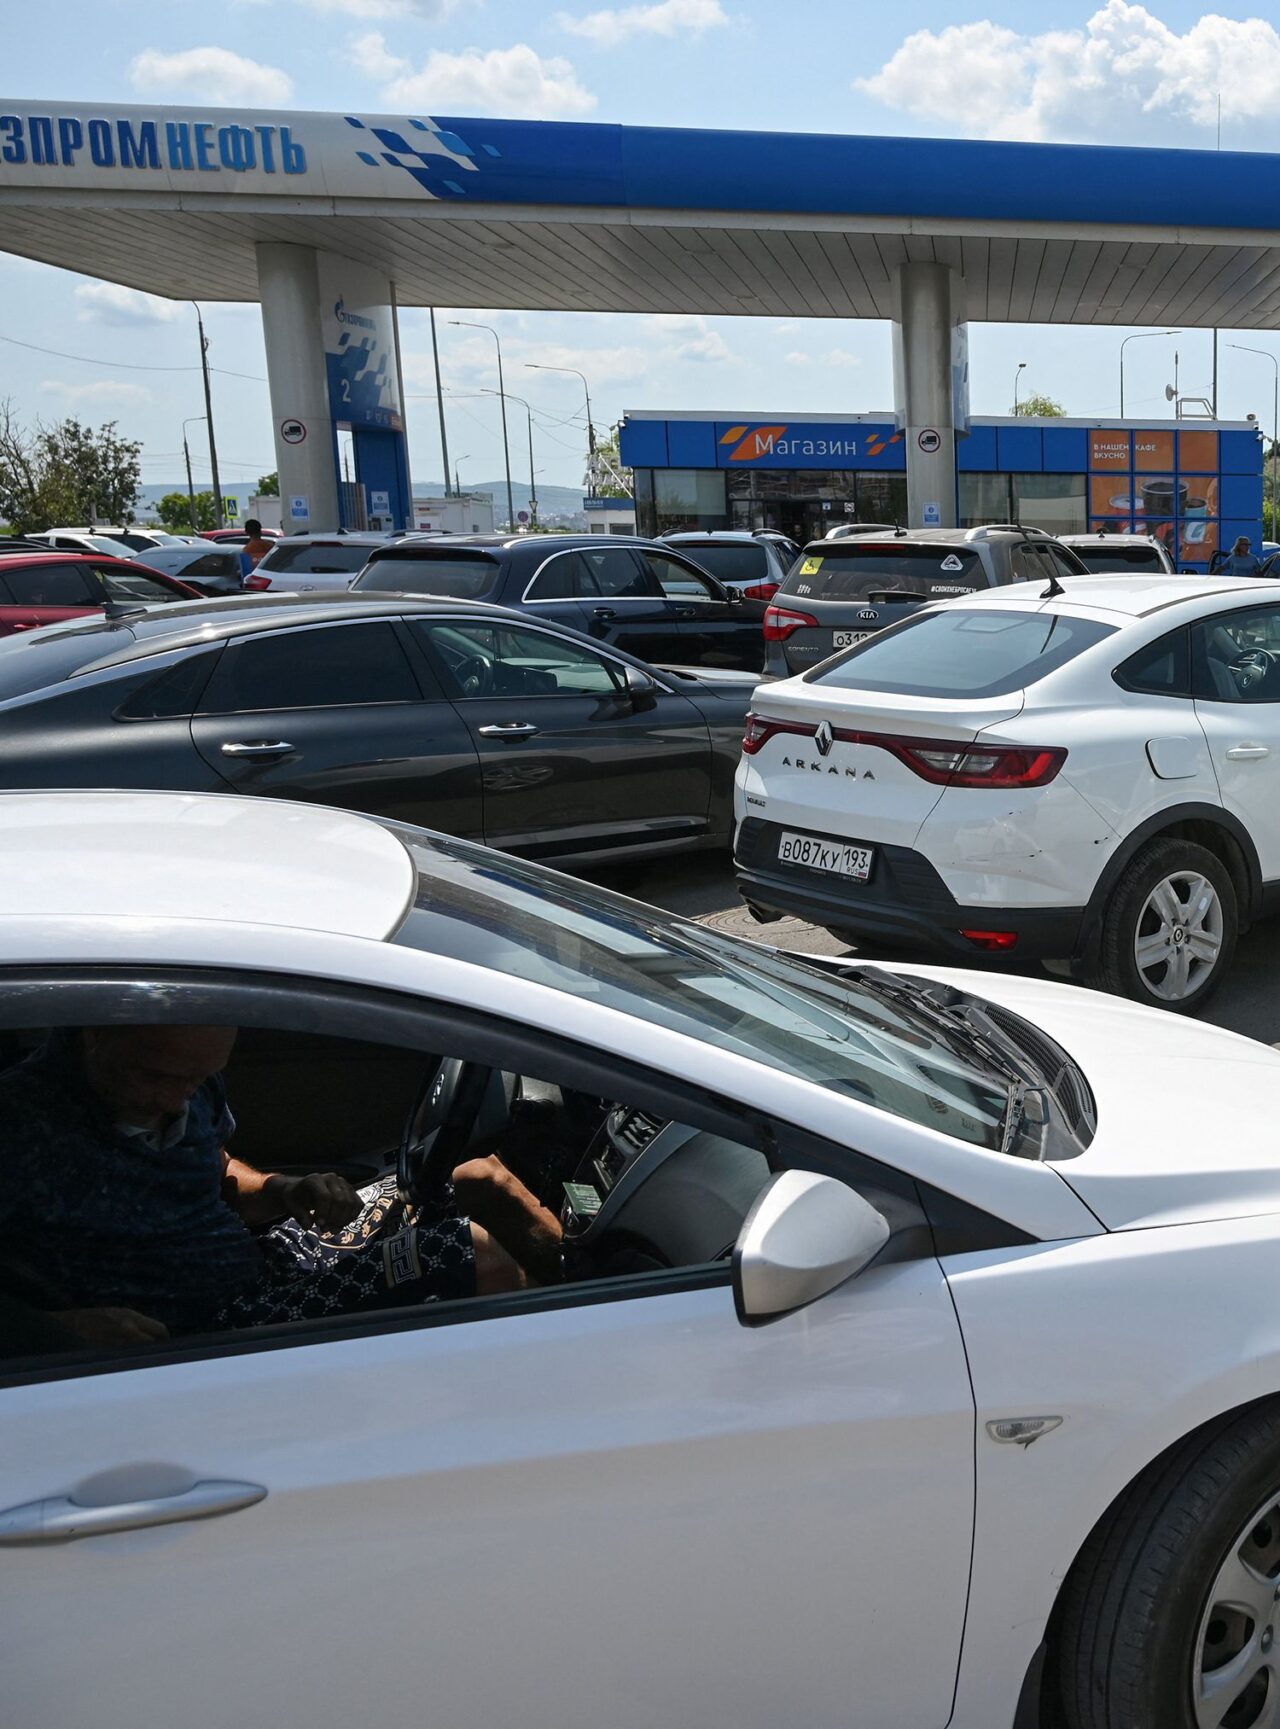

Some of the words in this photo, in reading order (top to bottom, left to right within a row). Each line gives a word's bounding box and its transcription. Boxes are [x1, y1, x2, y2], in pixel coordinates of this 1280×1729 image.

[0, 115, 308, 174] ЗПРОМНЕФТЬ
[341, 379, 351, 402] 2
[755, 433, 857, 456] Магазин
[1093, 443, 1099, 451] В
[1135, 444, 1157, 452] КАФЕ
[1093, 452, 1126, 460] ВКУСНО
[859, 611, 876, 619] KIA
[782, 756, 876, 780] ARKANA
[783, 839, 840, 869] В087КУ
[843, 848, 868, 869] 193
[847, 867, 859, 875] RUS
